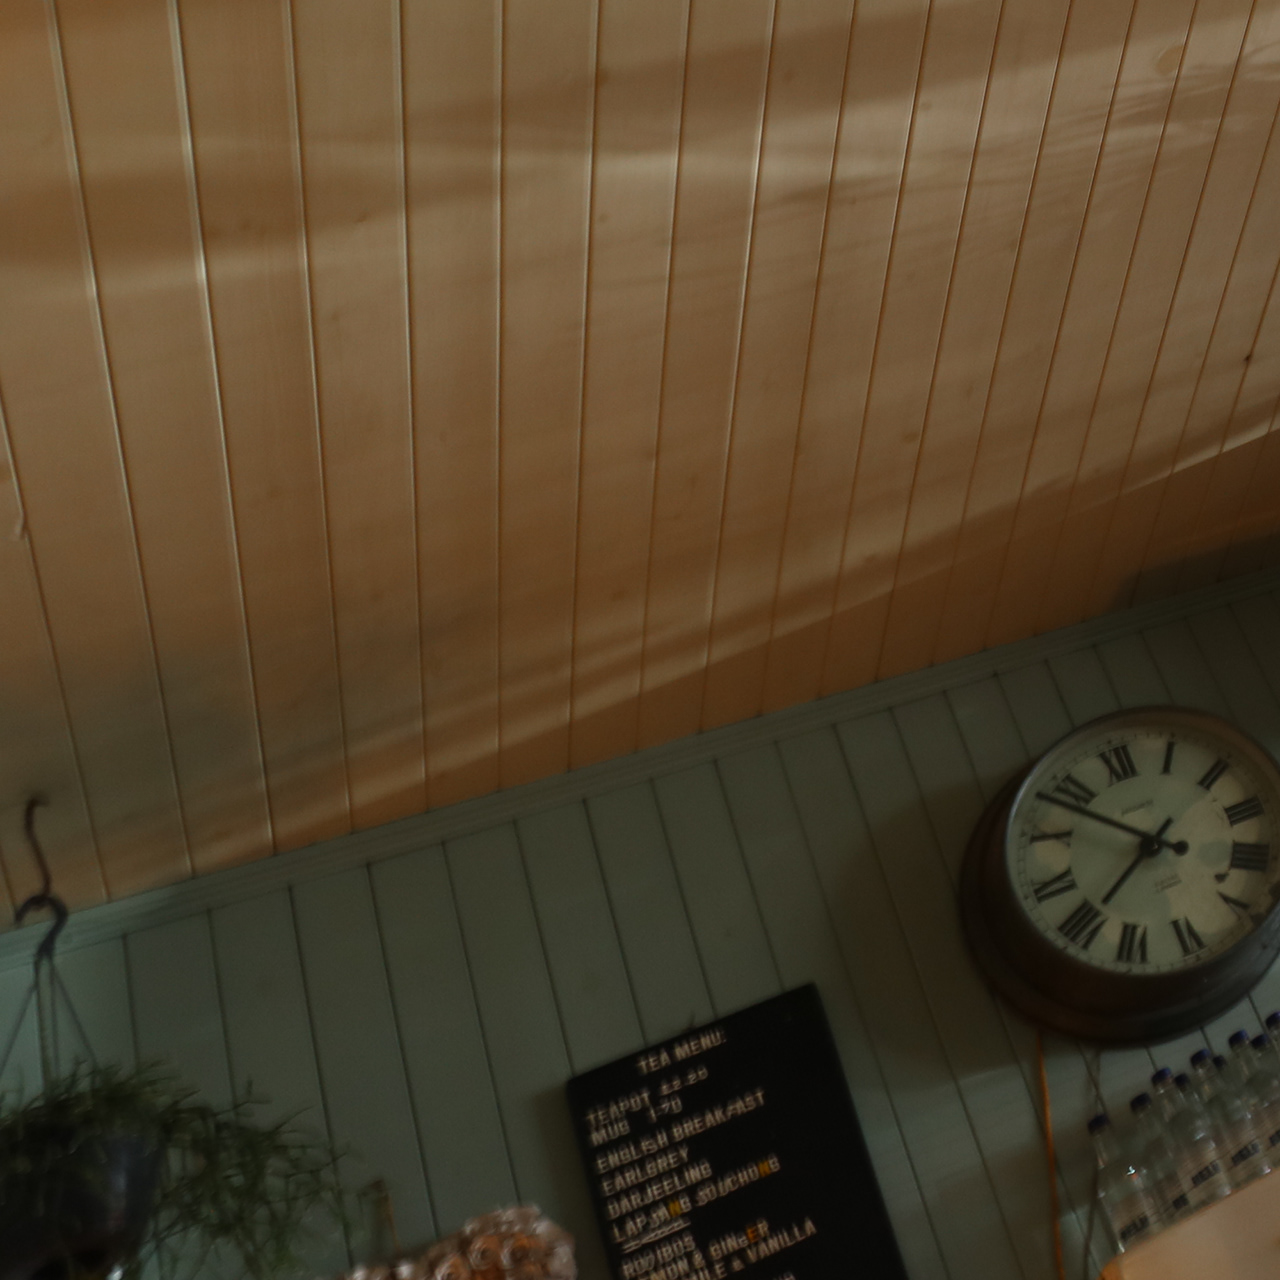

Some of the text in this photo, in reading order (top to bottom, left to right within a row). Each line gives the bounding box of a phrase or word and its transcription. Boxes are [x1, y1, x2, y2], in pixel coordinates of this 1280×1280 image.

[1100, 745, 1139, 786] XII
[1161, 741, 1175, 774] I
[1198, 758, 1229, 790] II
[1226, 796, 1264, 826] III
[638, 1048, 671, 1074] TEA
[586, 1088, 650, 1129] TEAPOT
[590, 1120, 631, 1147] MUG
[597, 1087, 766, 1174] ENGLISH BREAKFAST
[607, 1161, 713, 1219] DARJEELING
[612, 1153, 780, 1243] LAPSANG SOUCHONG
[622, 1230, 696, 1280] ROOIBOS
[746, 1217, 817, 1264] VANILLA
